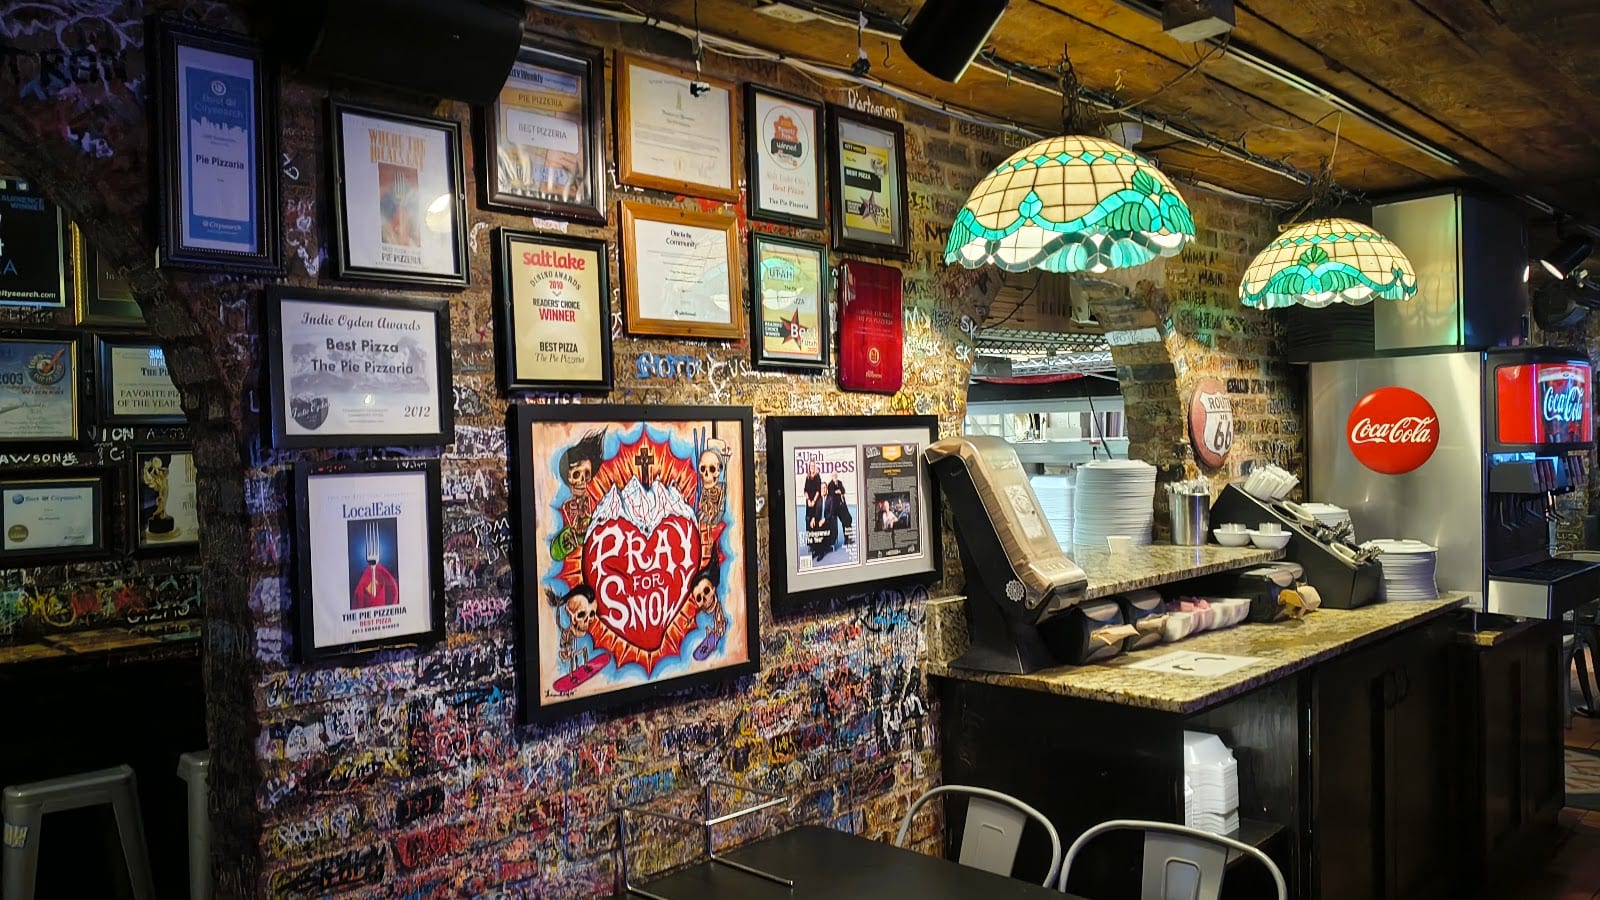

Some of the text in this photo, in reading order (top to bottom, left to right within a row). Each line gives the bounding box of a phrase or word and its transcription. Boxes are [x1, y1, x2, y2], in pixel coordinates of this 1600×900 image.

[518, 94, 564, 108] PIE PIZZERIA
[193, 102, 244, 120] Citysearch
[518, 123, 568, 140] BEST PIZZERIA
[196, 154, 245, 171] Pie Pizzaria
[845, 168, 872, 181] BEST PIZZA
[769, 197, 778, 205] The
[868, 203, 890, 218] Best
[665, 238, 698, 250] Community
[554, 270, 582, 291] AWARDS
[560, 299, 581, 310] CHOICE
[301, 312, 422, 331] Indie Ogden Awards
[538, 308, 576, 323] WINNER
[326, 337, 399, 353] Best Pizza
[539, 341, 578, 354] BEST PIZZA
[311, 358, 414, 376] The Pie Pizzeria
[120, 389, 167, 398] FAVORITE
[117, 399, 176, 408] OF THE YEAR
[403, 405, 431, 418] 2012
[1213, 420, 1232, 451] 66
[803, 450, 825, 462] Utah
[342, 501, 402, 519] LocalEats
[589, 517, 695, 588] PRAY
[632, 573, 665, 591] FOR
[600, 567, 691, 634] SNOW
[342, 606, 408, 623] THE PIE PIZZERIA
[376, 617, 392, 626] PIZZA
